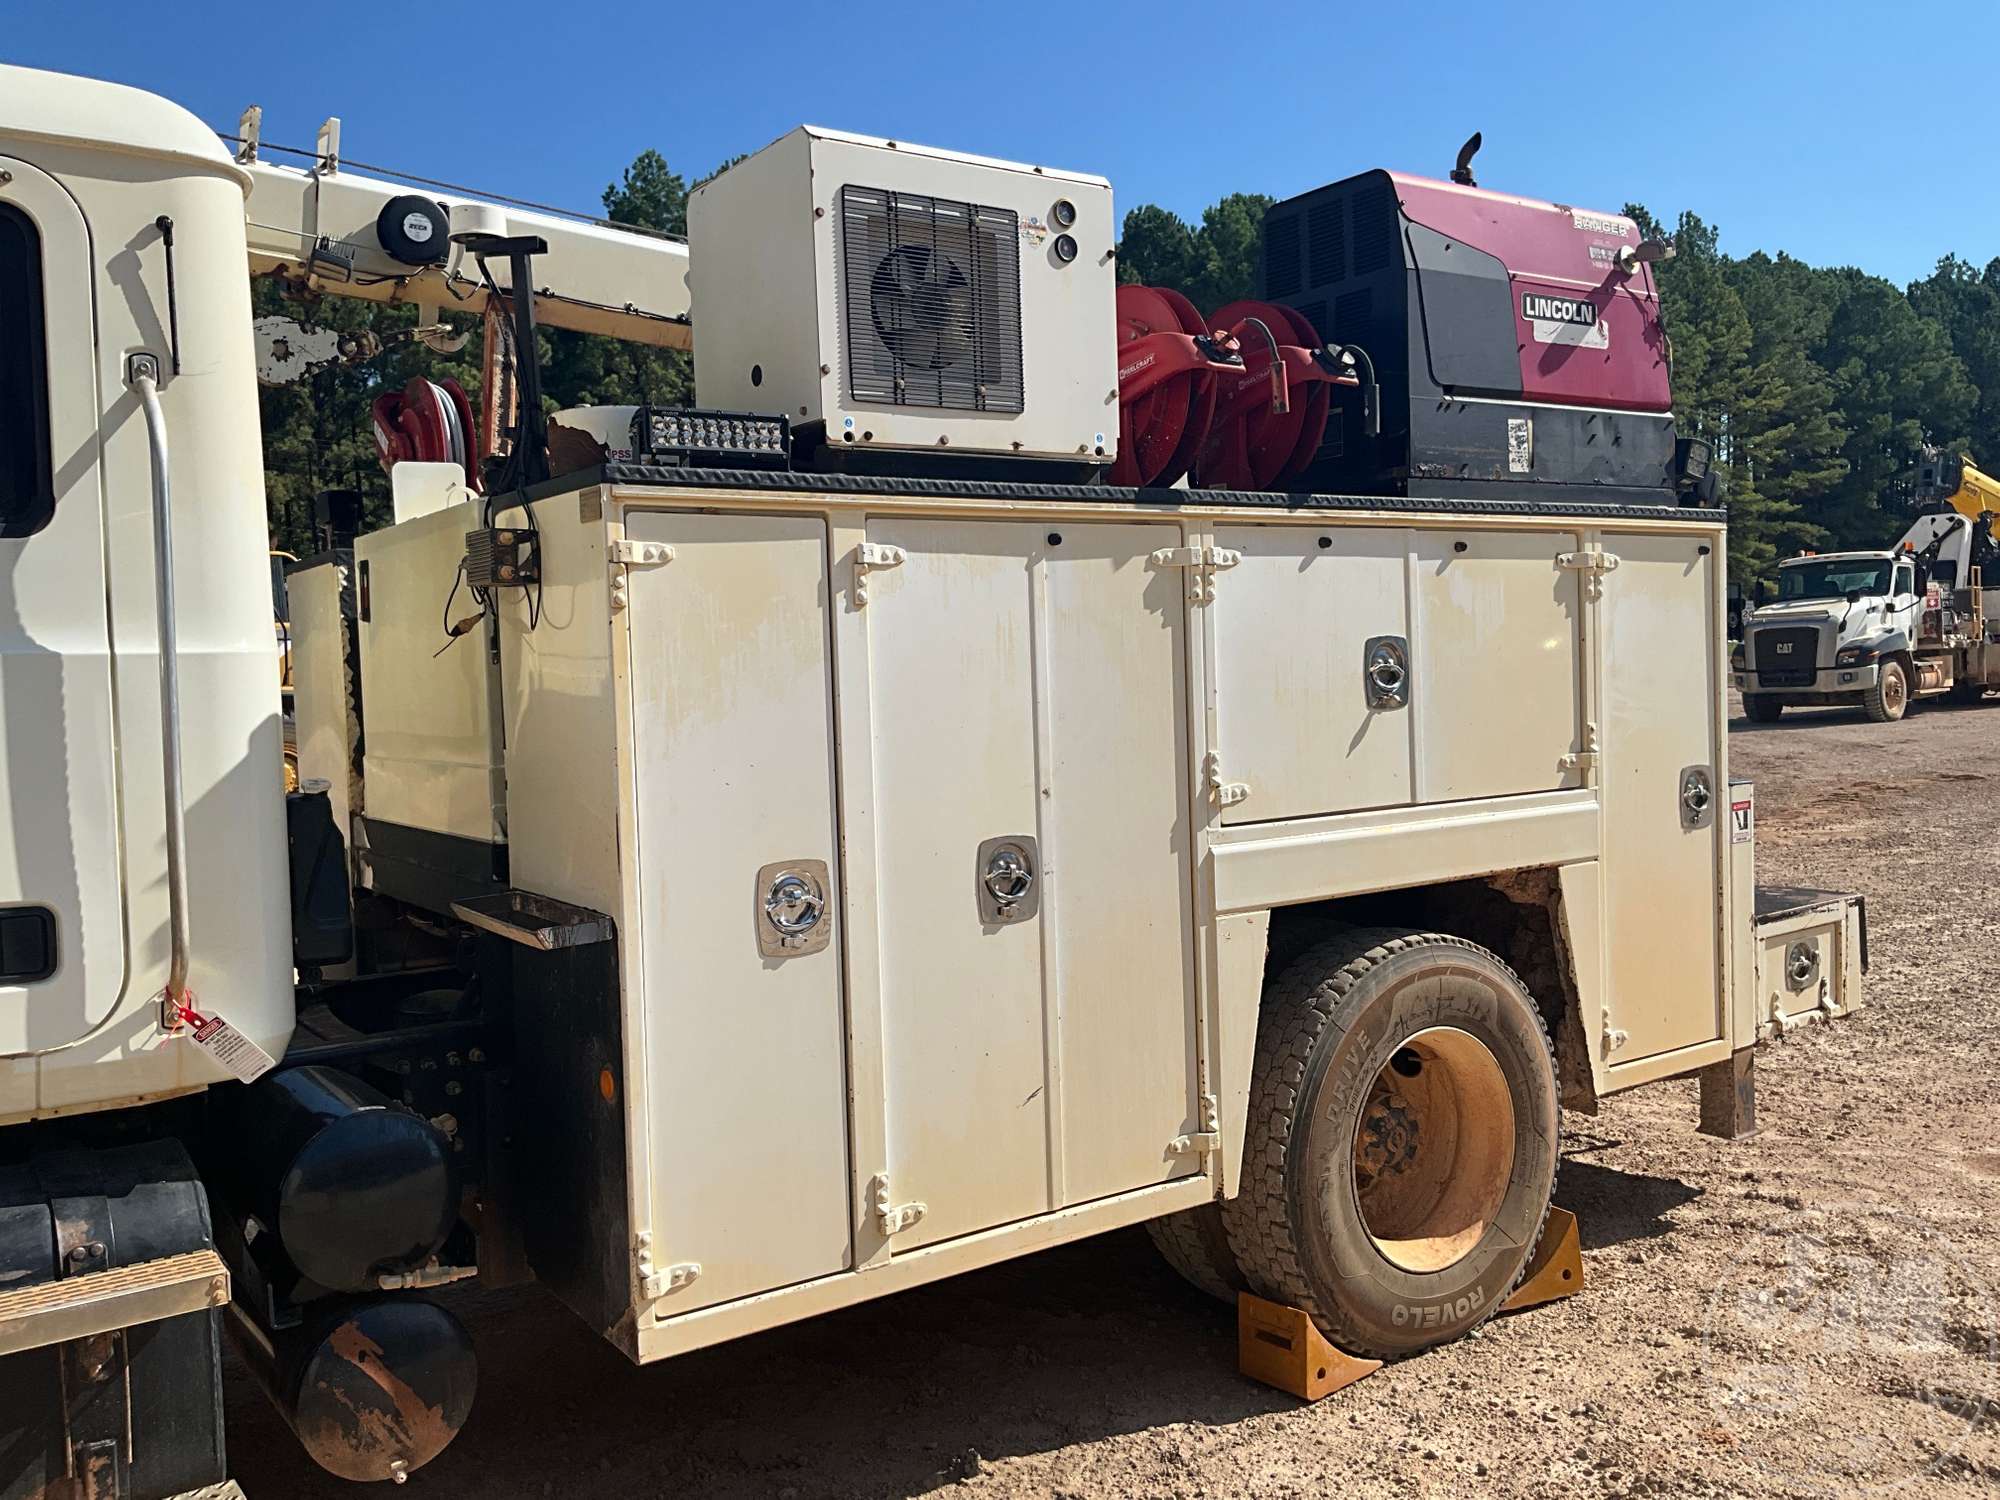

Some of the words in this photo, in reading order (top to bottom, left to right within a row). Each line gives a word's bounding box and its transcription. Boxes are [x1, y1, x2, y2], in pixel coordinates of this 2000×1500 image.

[1574, 215, 1629, 237] RANGER
[1525, 295, 1594, 324] LINCOLN
[1776, 642, 1793, 654] CAT
[1391, 1285, 1486, 1329] ROVELO
